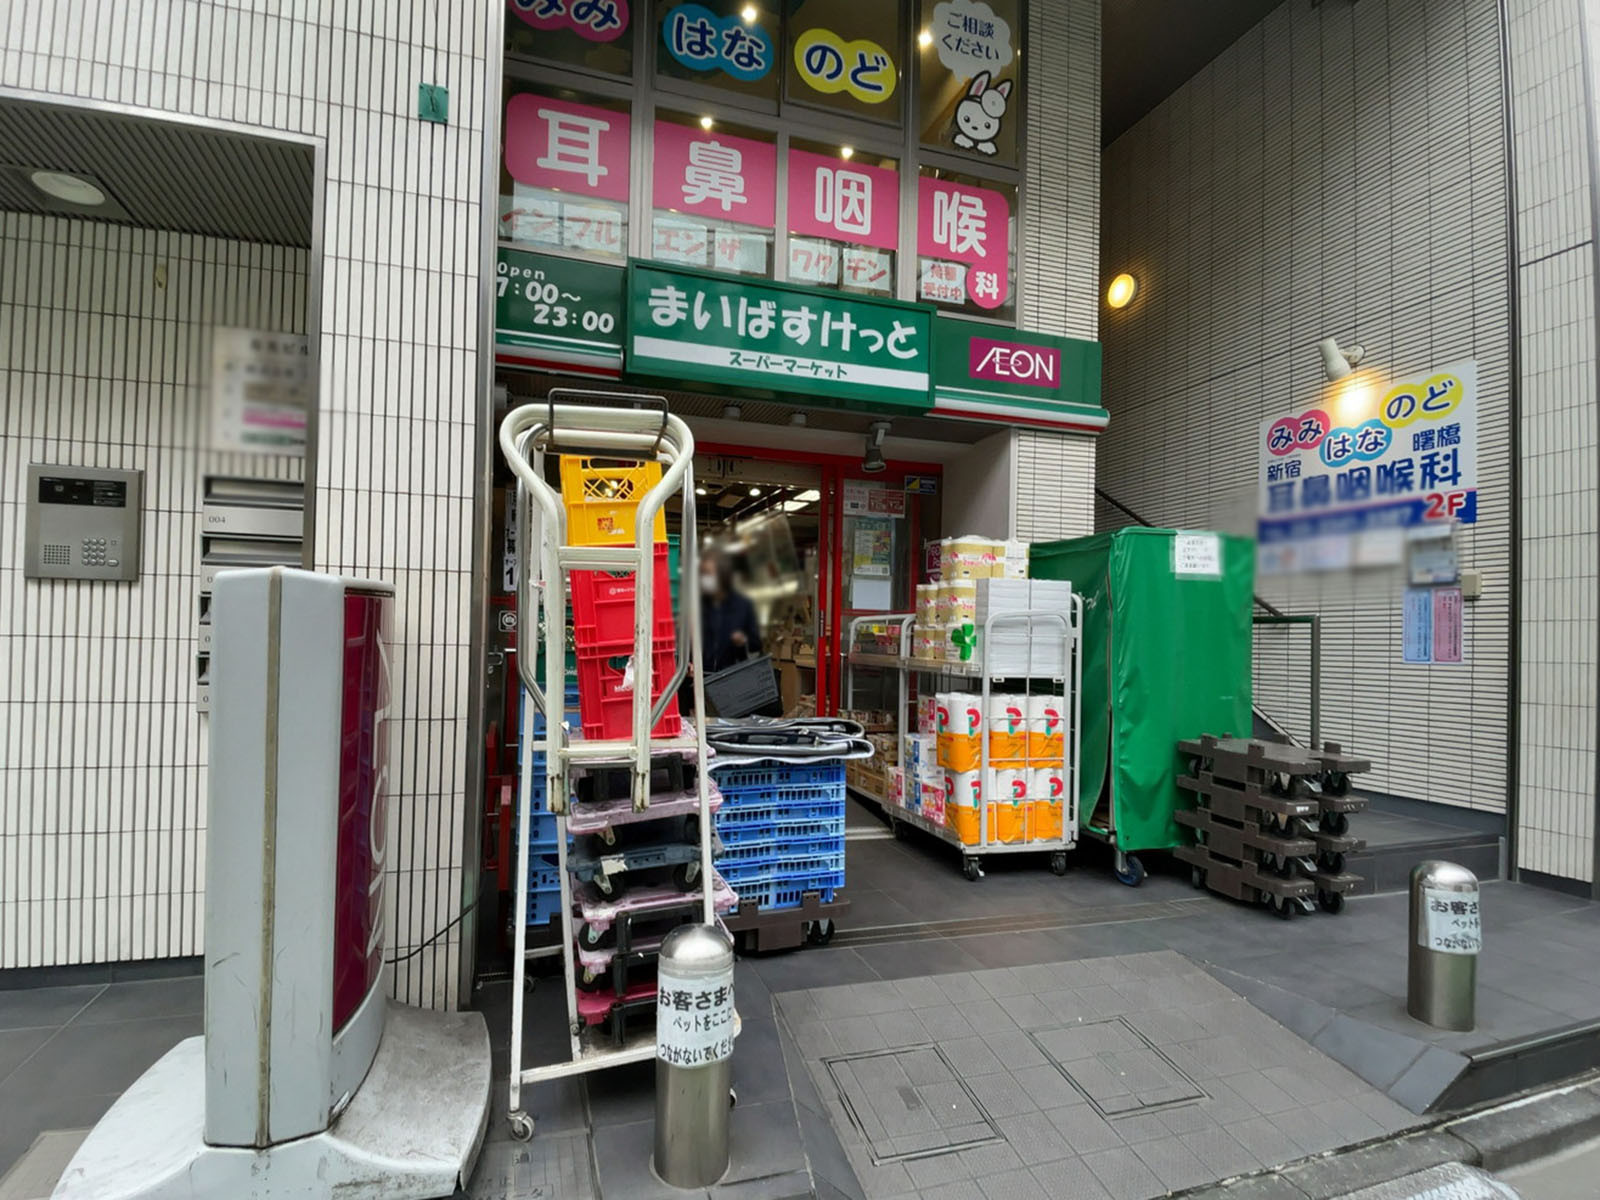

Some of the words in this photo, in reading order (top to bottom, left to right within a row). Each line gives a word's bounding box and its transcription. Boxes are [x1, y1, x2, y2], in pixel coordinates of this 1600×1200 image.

[947, 12, 994, 39] ご相談
[675, 14, 766, 71] はな
[942, 34, 1000, 60] ください
[804, 44, 888, 92] のど
[533, 303, 615, 334] 23:00
[648, 285, 919, 360] まいばすけっと
[729, 351, 848, 380] スーパーマーケット
[1386, 380, 1454, 420] のど
[1270, 418, 1323, 449] みみ
[1326, 428, 1386, 460] はな
[1267, 460, 1302, 482] 新宿
[1423, 493, 1465, 519] 2F
